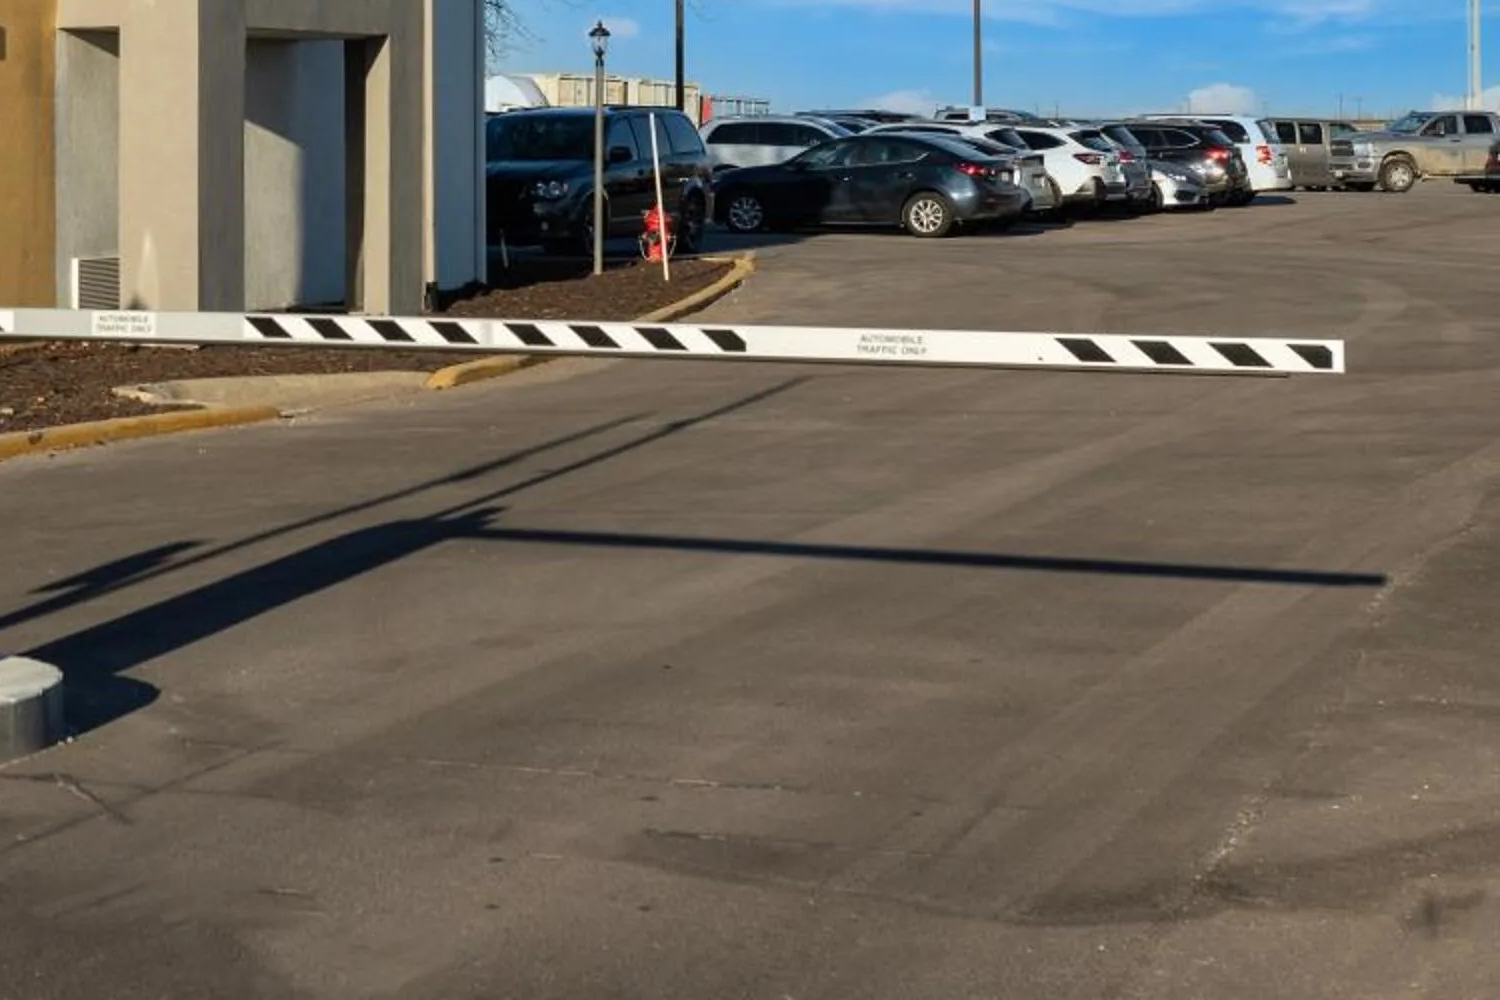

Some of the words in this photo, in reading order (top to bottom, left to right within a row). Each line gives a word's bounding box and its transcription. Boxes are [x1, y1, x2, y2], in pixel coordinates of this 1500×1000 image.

[861, 334, 923, 345] AUTOMOBILE
[857, 344, 898, 355] TRAFFIC
[902, 346, 927, 356] ONLY
